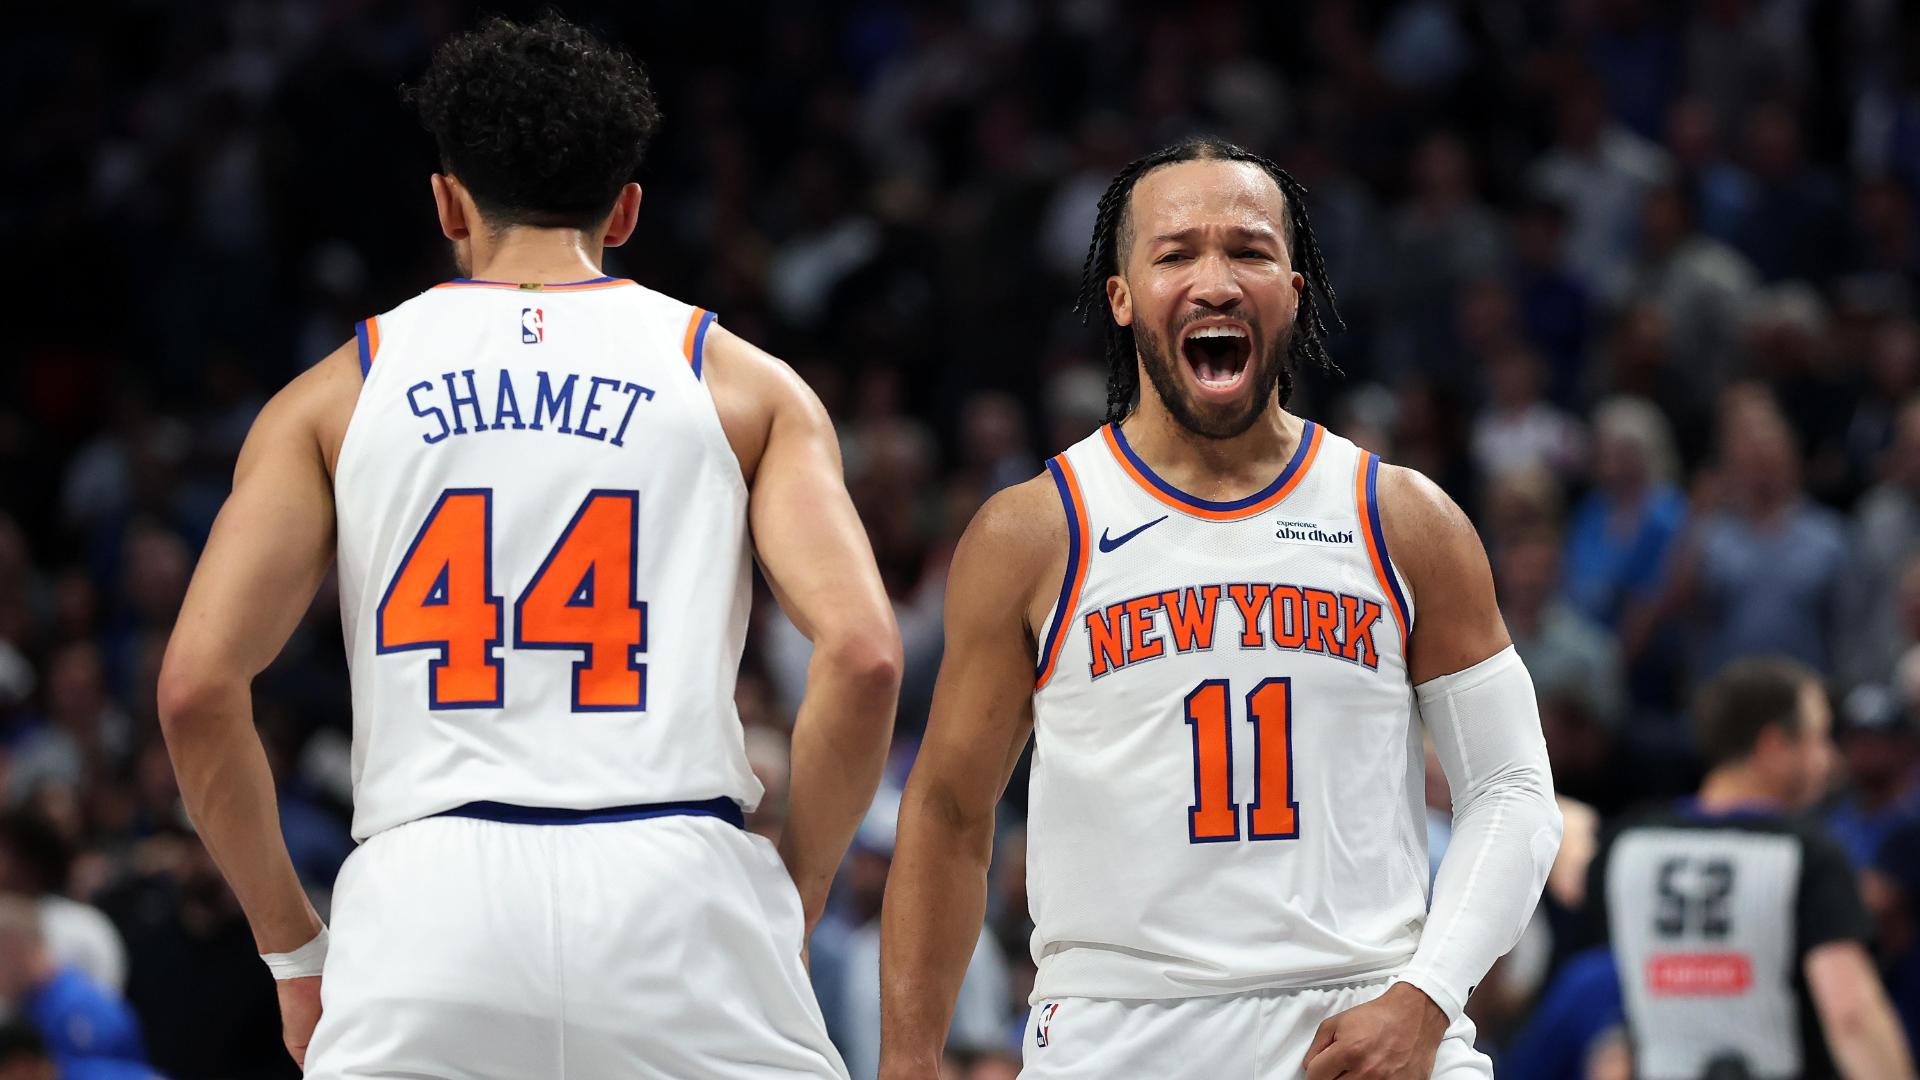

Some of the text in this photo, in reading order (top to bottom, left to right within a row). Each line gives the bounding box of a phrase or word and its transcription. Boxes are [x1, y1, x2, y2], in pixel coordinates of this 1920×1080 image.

[406, 369, 655, 447] SHAMET
[1276, 520, 1317, 528] experience
[1276, 528, 1306, 540] abu
[376, 487, 648, 713] 44
[1084, 583, 1384, 681] NEW YORK
[1184, 677, 1299, 844] 11
[1656, 858, 1735, 938] 52
